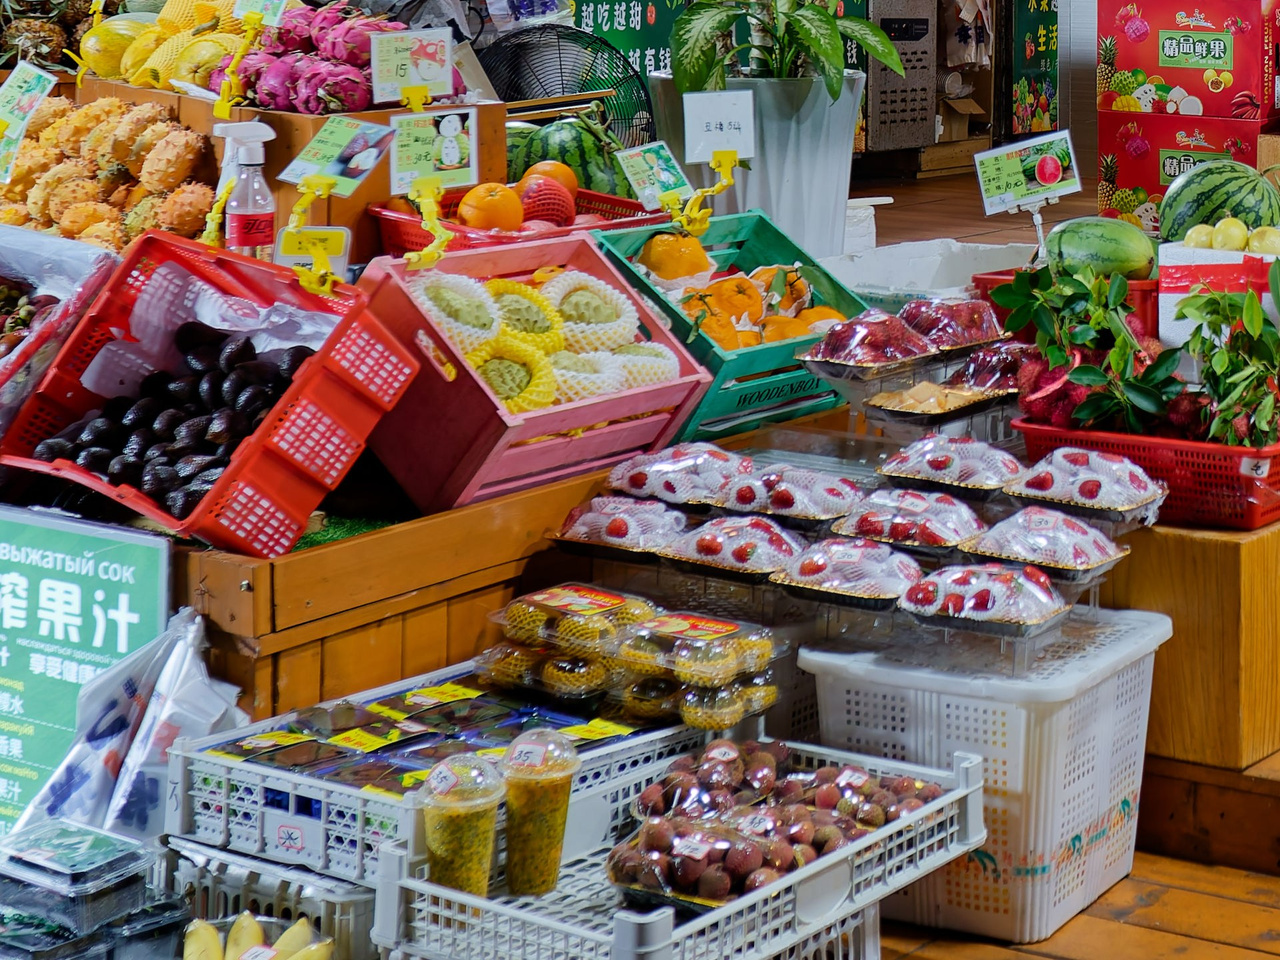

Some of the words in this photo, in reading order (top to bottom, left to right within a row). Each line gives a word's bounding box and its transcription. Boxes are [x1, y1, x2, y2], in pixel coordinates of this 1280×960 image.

[568, 0, 643, 32] 越吃越甜
[1163, 35, 1225, 58] 精品鲜果
[736, 377, 821, 408] WOODENBOX
[98, 561, 136, 585] сок
